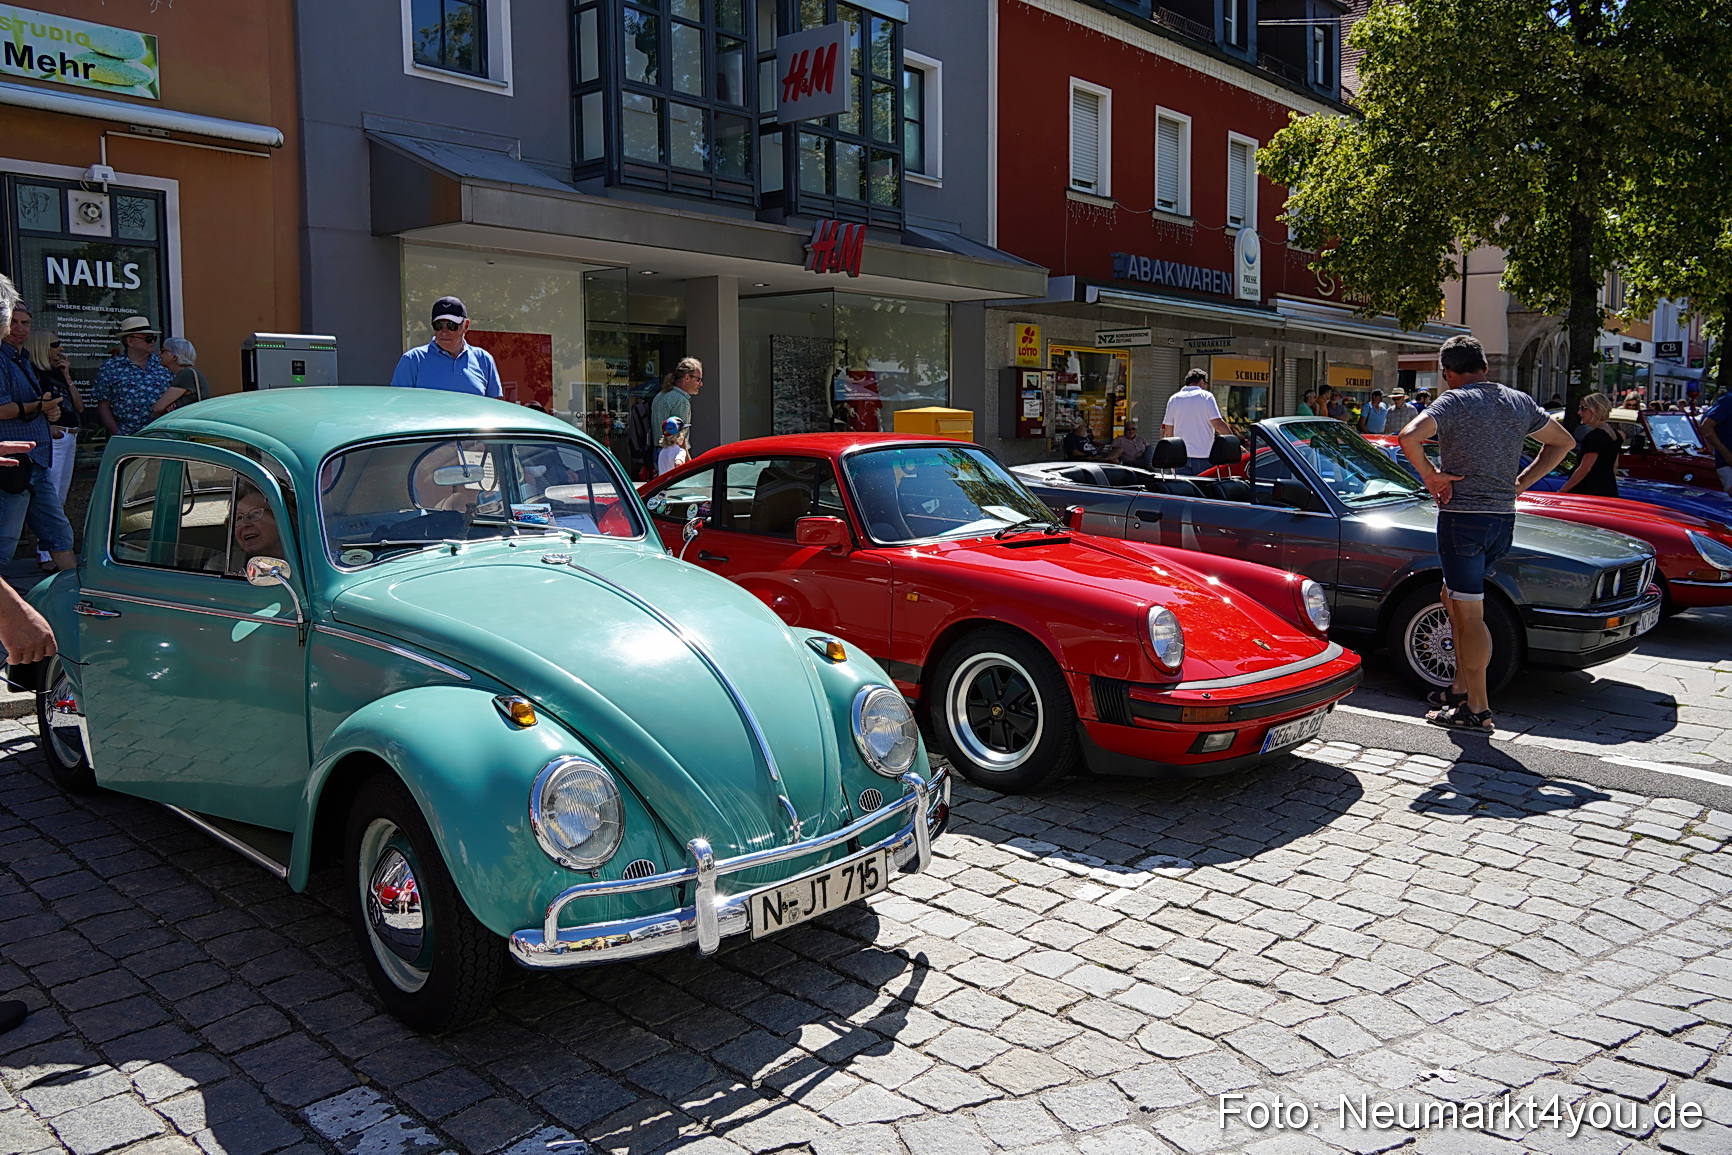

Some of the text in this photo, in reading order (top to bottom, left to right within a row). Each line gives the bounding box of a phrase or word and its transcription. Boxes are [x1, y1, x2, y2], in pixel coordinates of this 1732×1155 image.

[0, 16, 91, 47] STUDIO
[4, 41, 96, 80] Mehr
[782, 42, 837, 103] H&M
[804, 219, 866, 278] H&M
[46, 256, 141, 290] NAILS
[1018, 347, 1038, 357] LOTTO
[1098, 334, 1115, 345] NZ
[1188, 340, 1232, 349] NEUMARKTER
[1661, 343, 1676, 353] CB
[842, 857, 879, 902] 715
